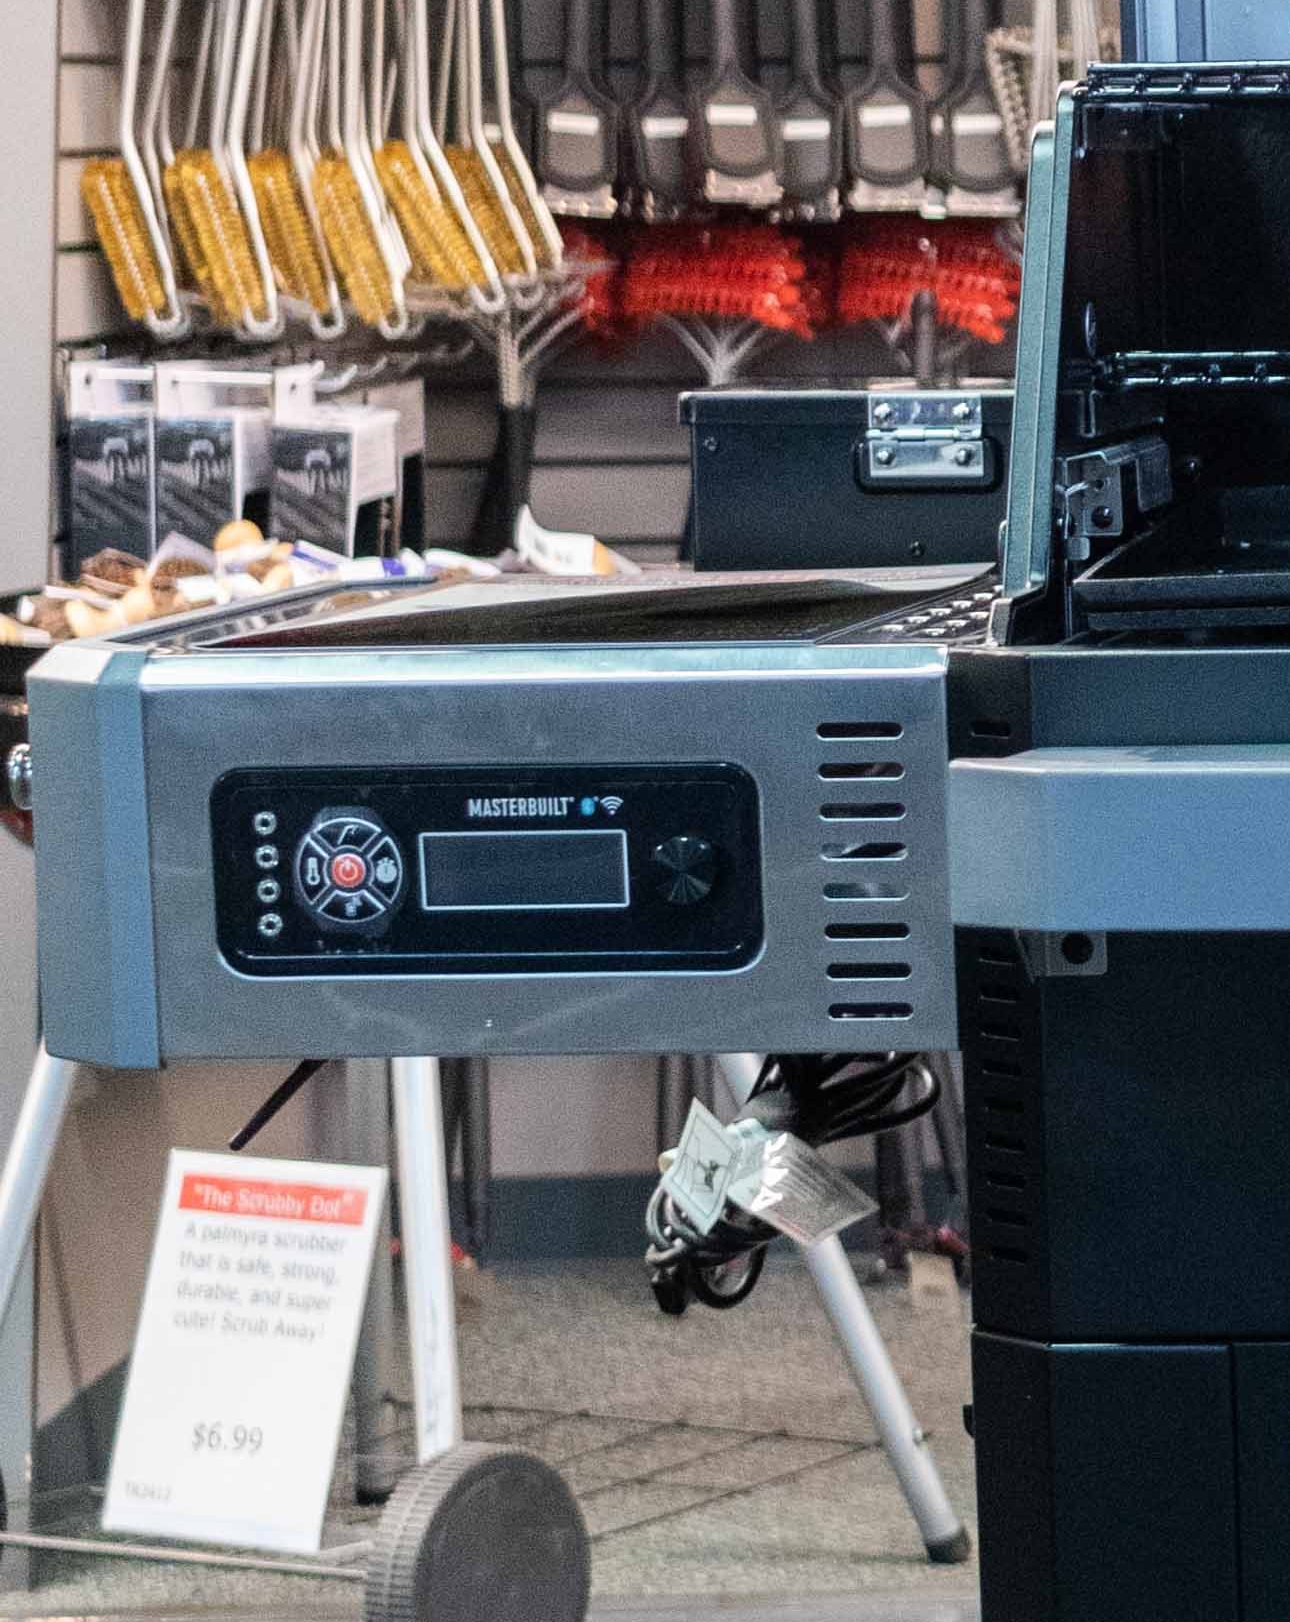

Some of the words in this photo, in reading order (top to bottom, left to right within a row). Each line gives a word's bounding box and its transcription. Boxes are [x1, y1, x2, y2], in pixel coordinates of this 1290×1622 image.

[468, 796, 570, 818] MASTERBUILT
[237, 1188, 305, 1213] Scrubby
[273, 1231, 347, 1252] scrubber
[179, 1250, 212, 1268] that
[218, 1255, 231, 1271] is
[249, 1288, 282, 1306] and
[285, 1294, 333, 1313] super
[221, 1312, 269, 1333] Scrub
[191, 1421, 264, 1455] $6.99
